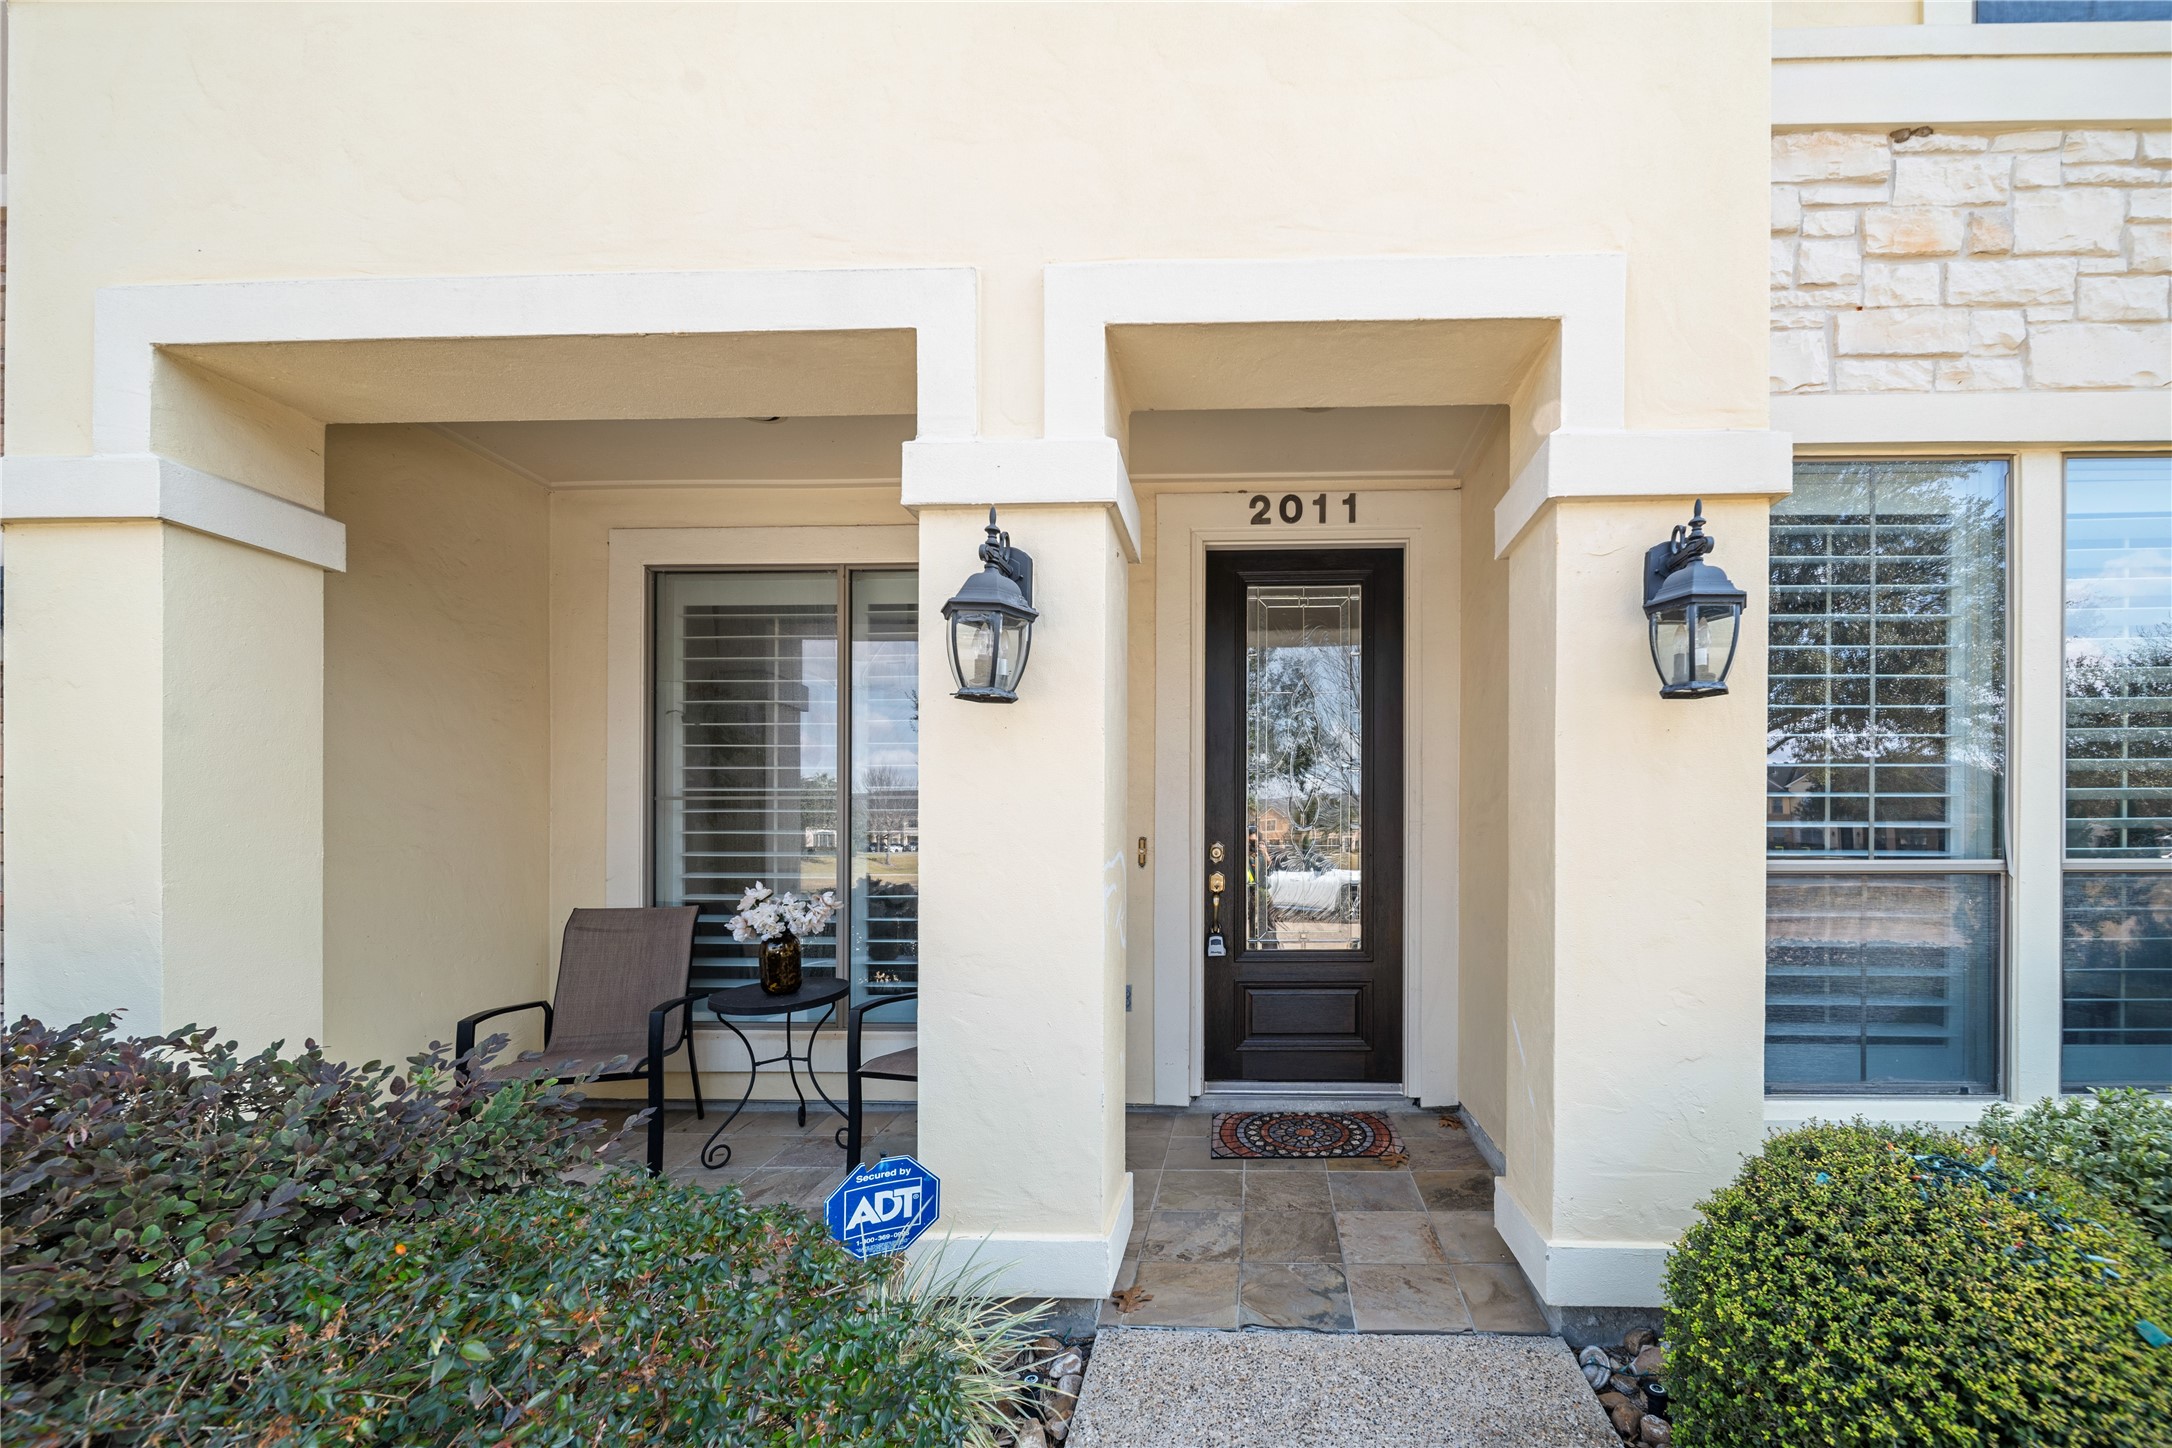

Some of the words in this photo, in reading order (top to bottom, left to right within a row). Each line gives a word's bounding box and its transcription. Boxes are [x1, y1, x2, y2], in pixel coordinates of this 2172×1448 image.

[1249, 493, 1356, 525] 2011
[855, 1169, 897, 1183] Secured
[899, 1168, 911, 1176] by
[846, 1186, 920, 1230] ADT
